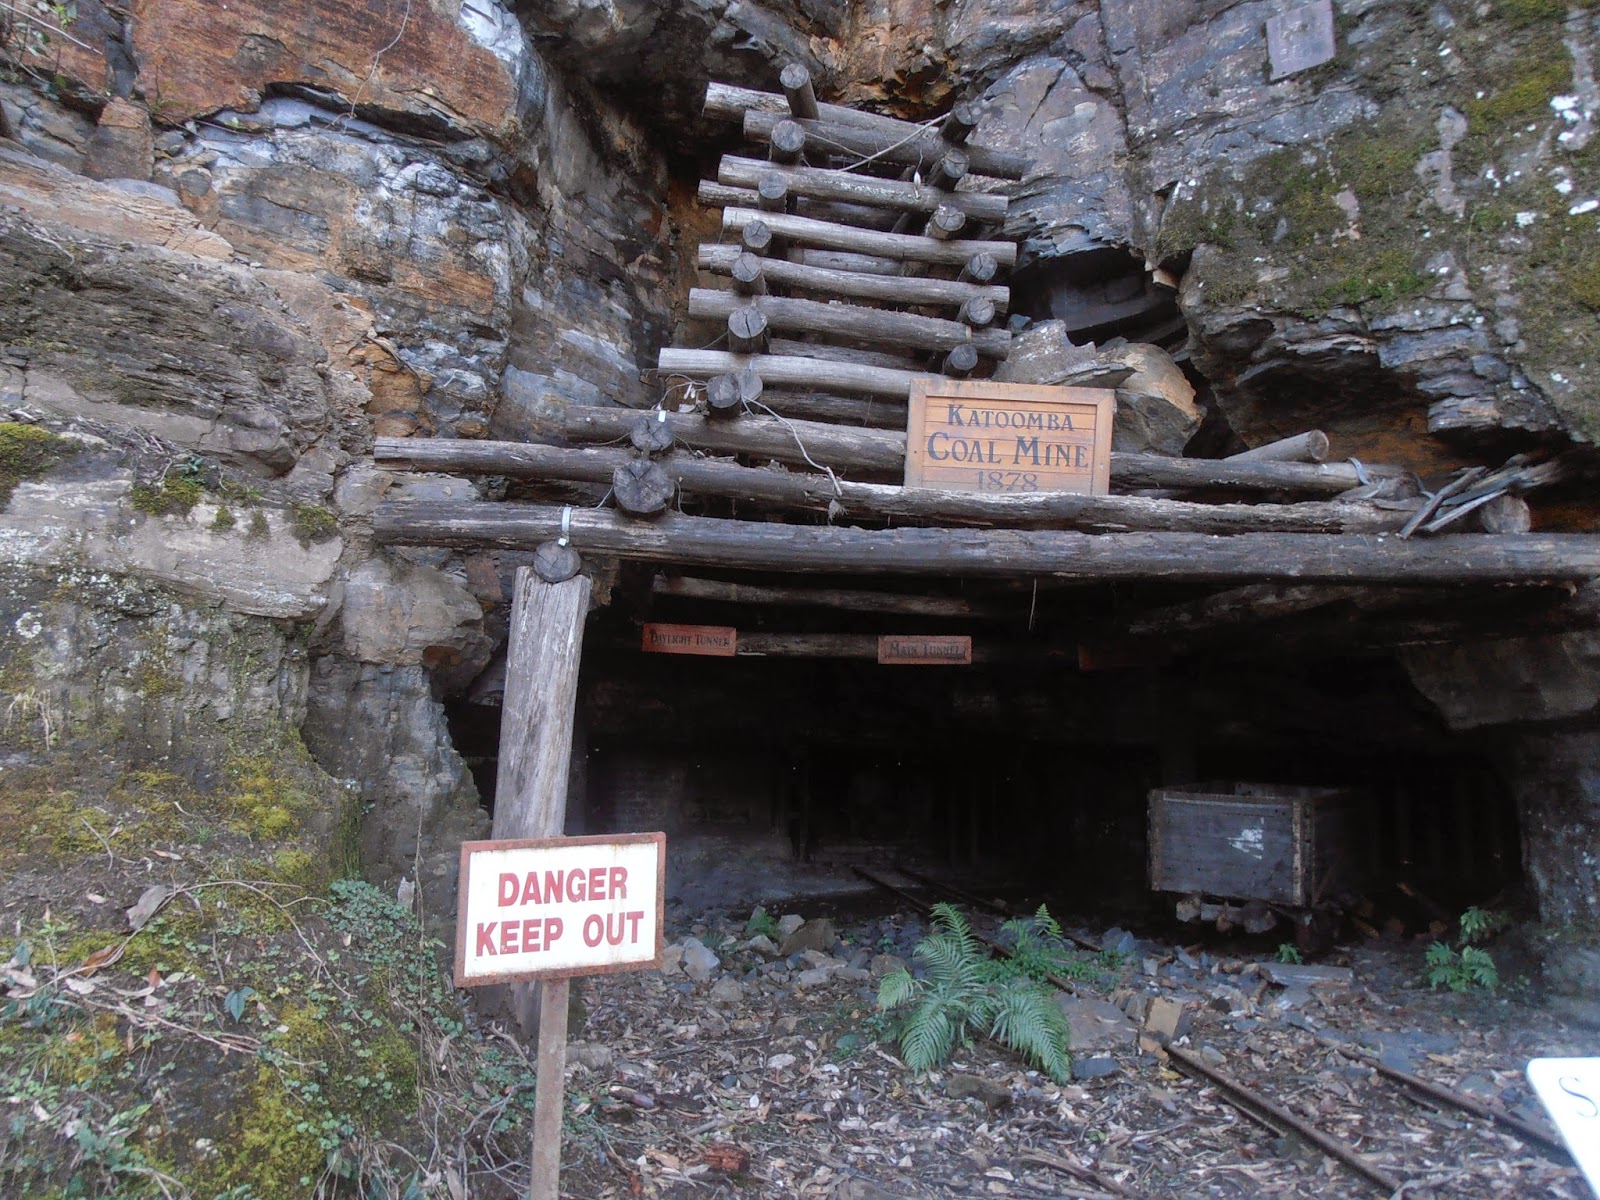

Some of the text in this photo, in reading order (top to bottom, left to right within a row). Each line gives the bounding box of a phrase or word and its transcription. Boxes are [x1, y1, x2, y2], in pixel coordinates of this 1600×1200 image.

[947, 403, 1075, 432] KATOOMBA
[927, 431, 1089, 469] COAL MINE
[975, 470, 1039, 493] 1878
[649, 628, 692, 646] DAYLIGHT
[498, 866, 628, 907] DANGER
[476, 911, 644, 957] KEEP OUT
